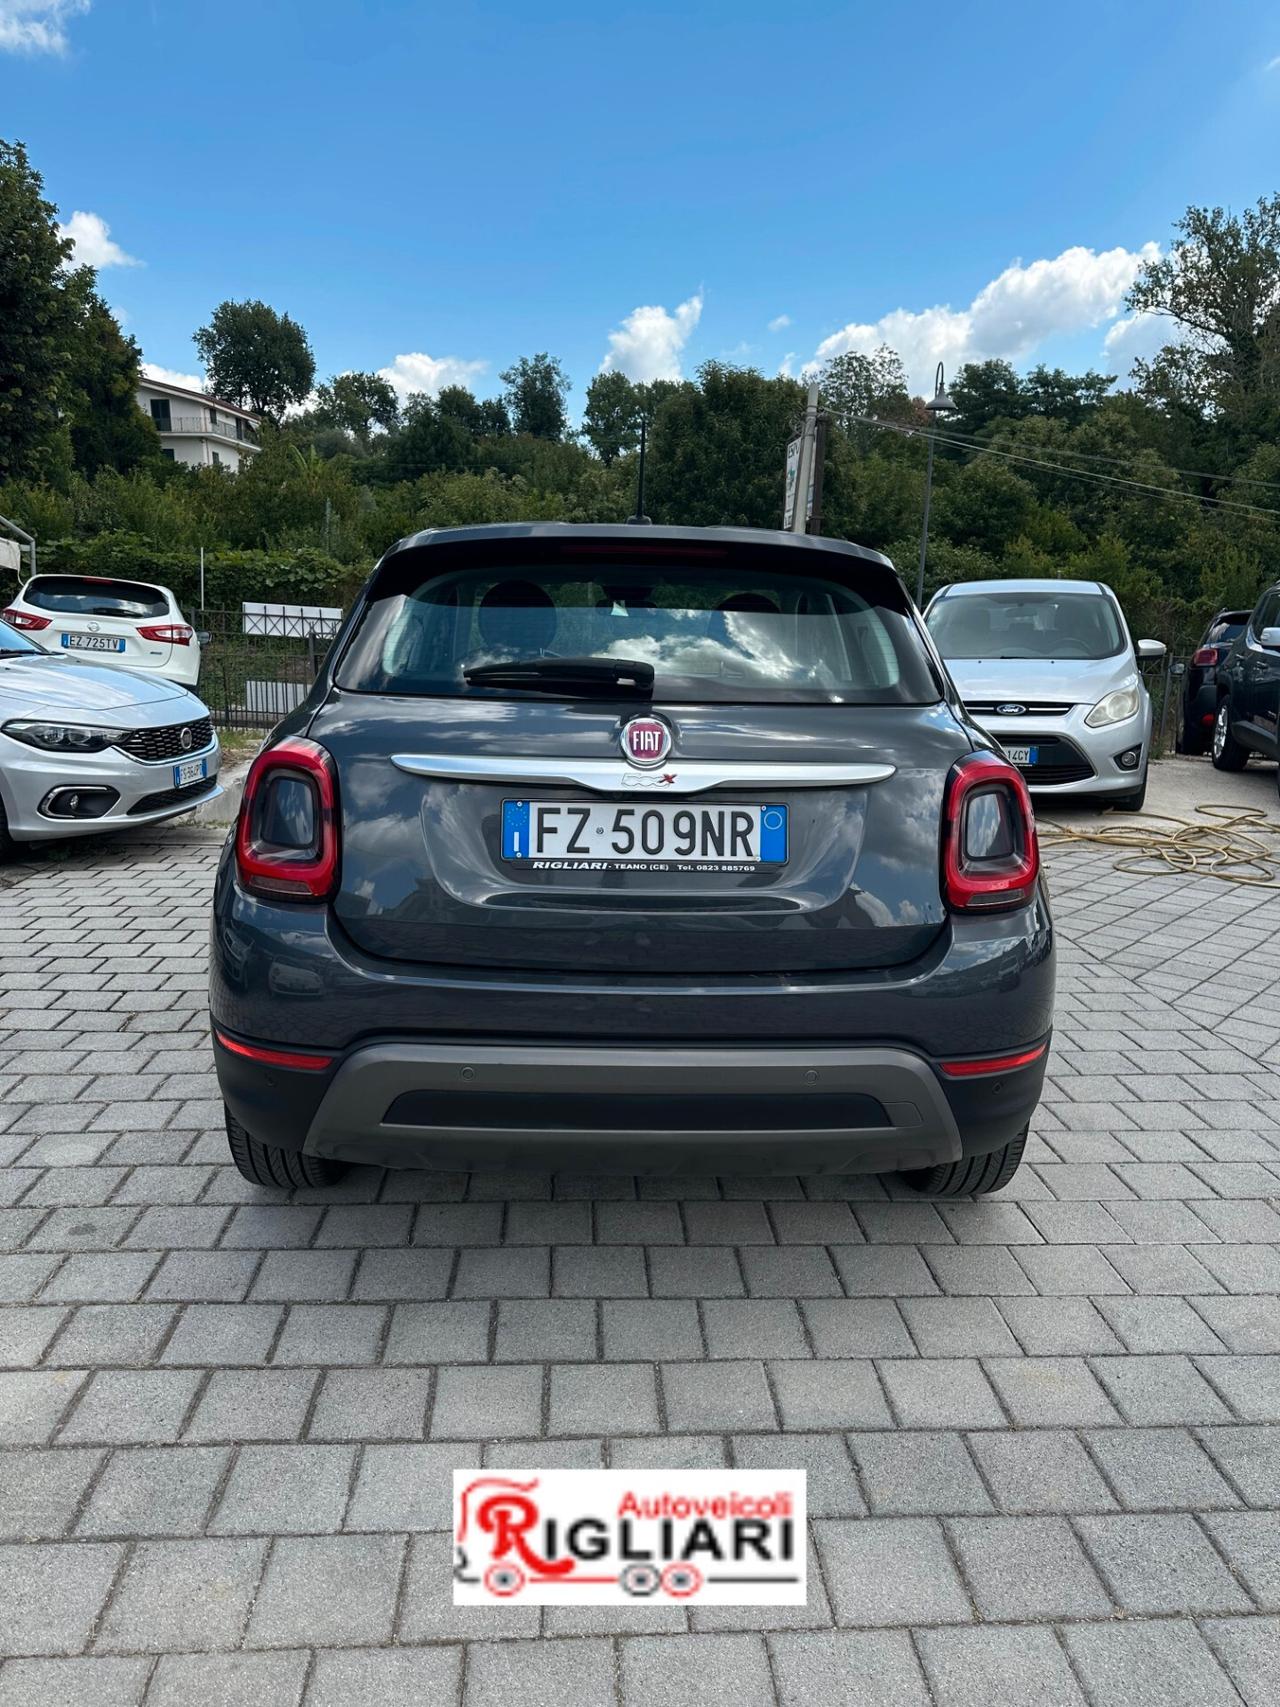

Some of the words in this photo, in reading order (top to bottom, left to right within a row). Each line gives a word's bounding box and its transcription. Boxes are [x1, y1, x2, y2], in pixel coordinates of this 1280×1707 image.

[69, 635, 83, 647] EZ
[86, 637, 119, 649] 725TV
[633, 730, 661, 751] FIAT
[1007, 750, 1029, 761] 14CY
[536, 807, 591, 854] FZ
[611, 808, 755, 857] 509NR
[532, 861, 608, 870] RIGLIARI
[649, 863, 669, 871] (CE)
[677, 863, 694, 871] Tel.
